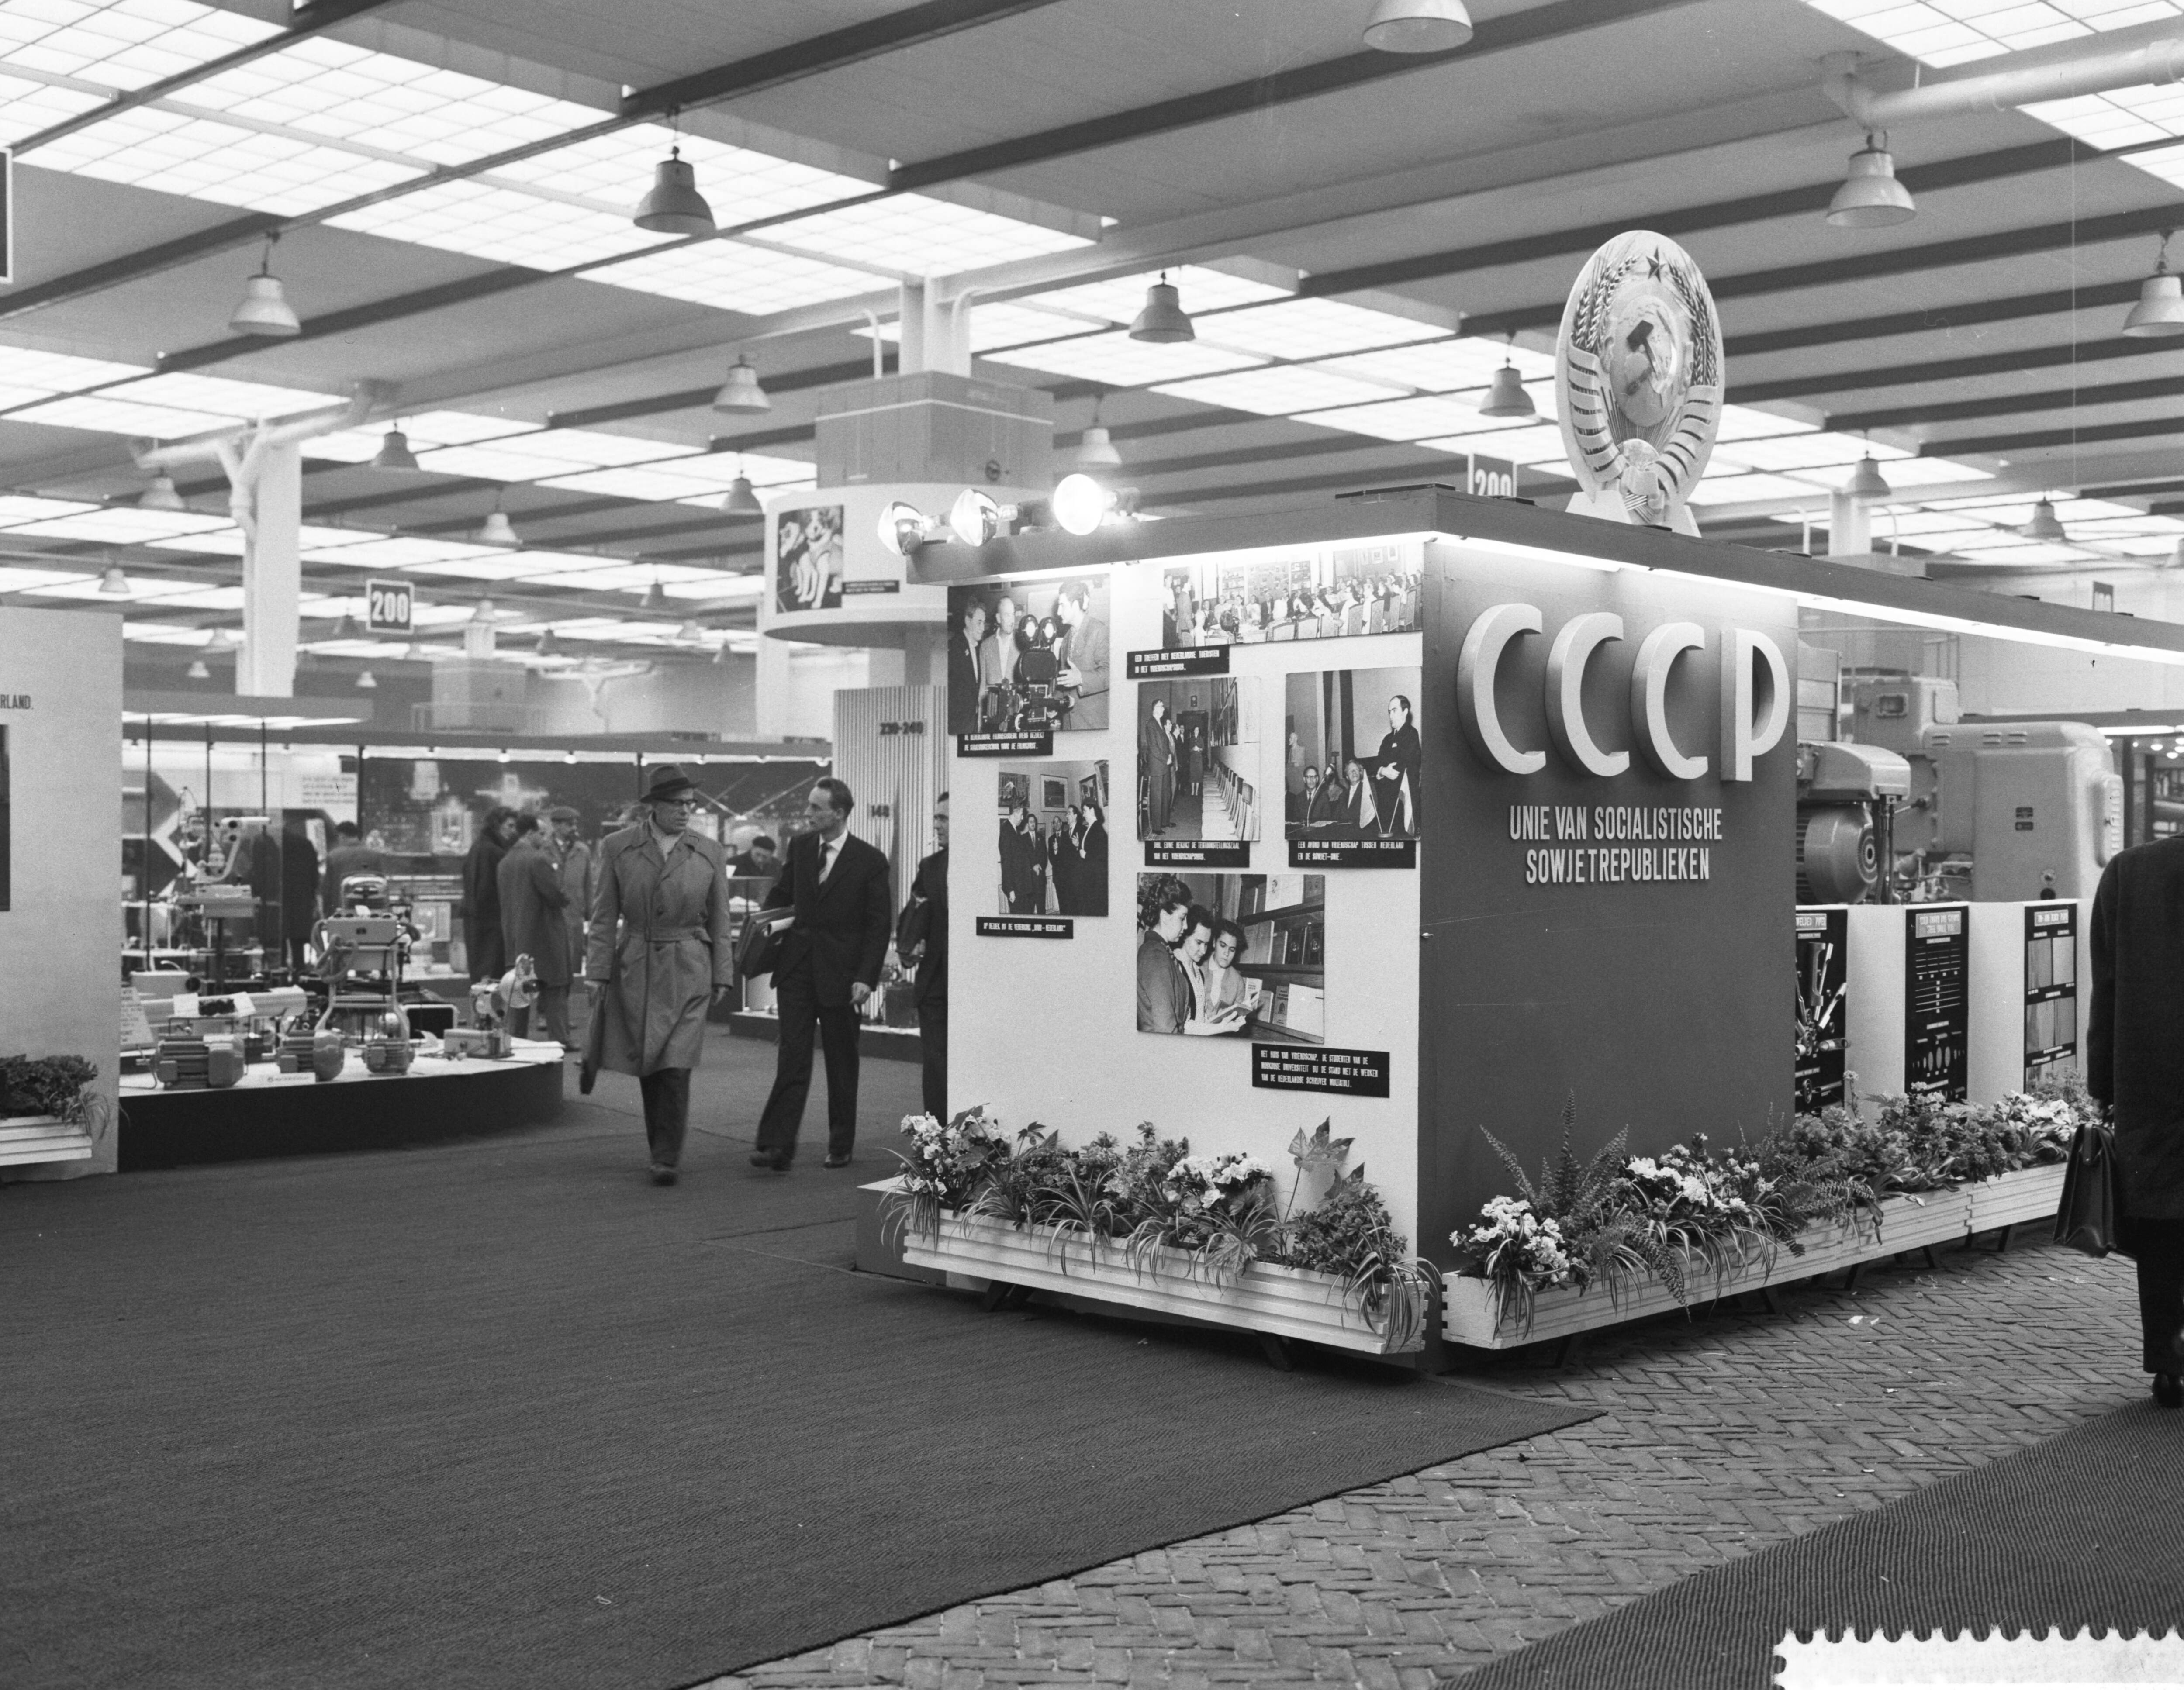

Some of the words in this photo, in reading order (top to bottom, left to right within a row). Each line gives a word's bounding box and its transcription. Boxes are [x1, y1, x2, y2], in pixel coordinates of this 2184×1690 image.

[372, 591, 408, 623] 200
[1510, 806, 1550, 840] UNIE
[1555, 807, 1586, 839] VAN
[1595, 807, 1722, 839] SOCIALISTISCHE
